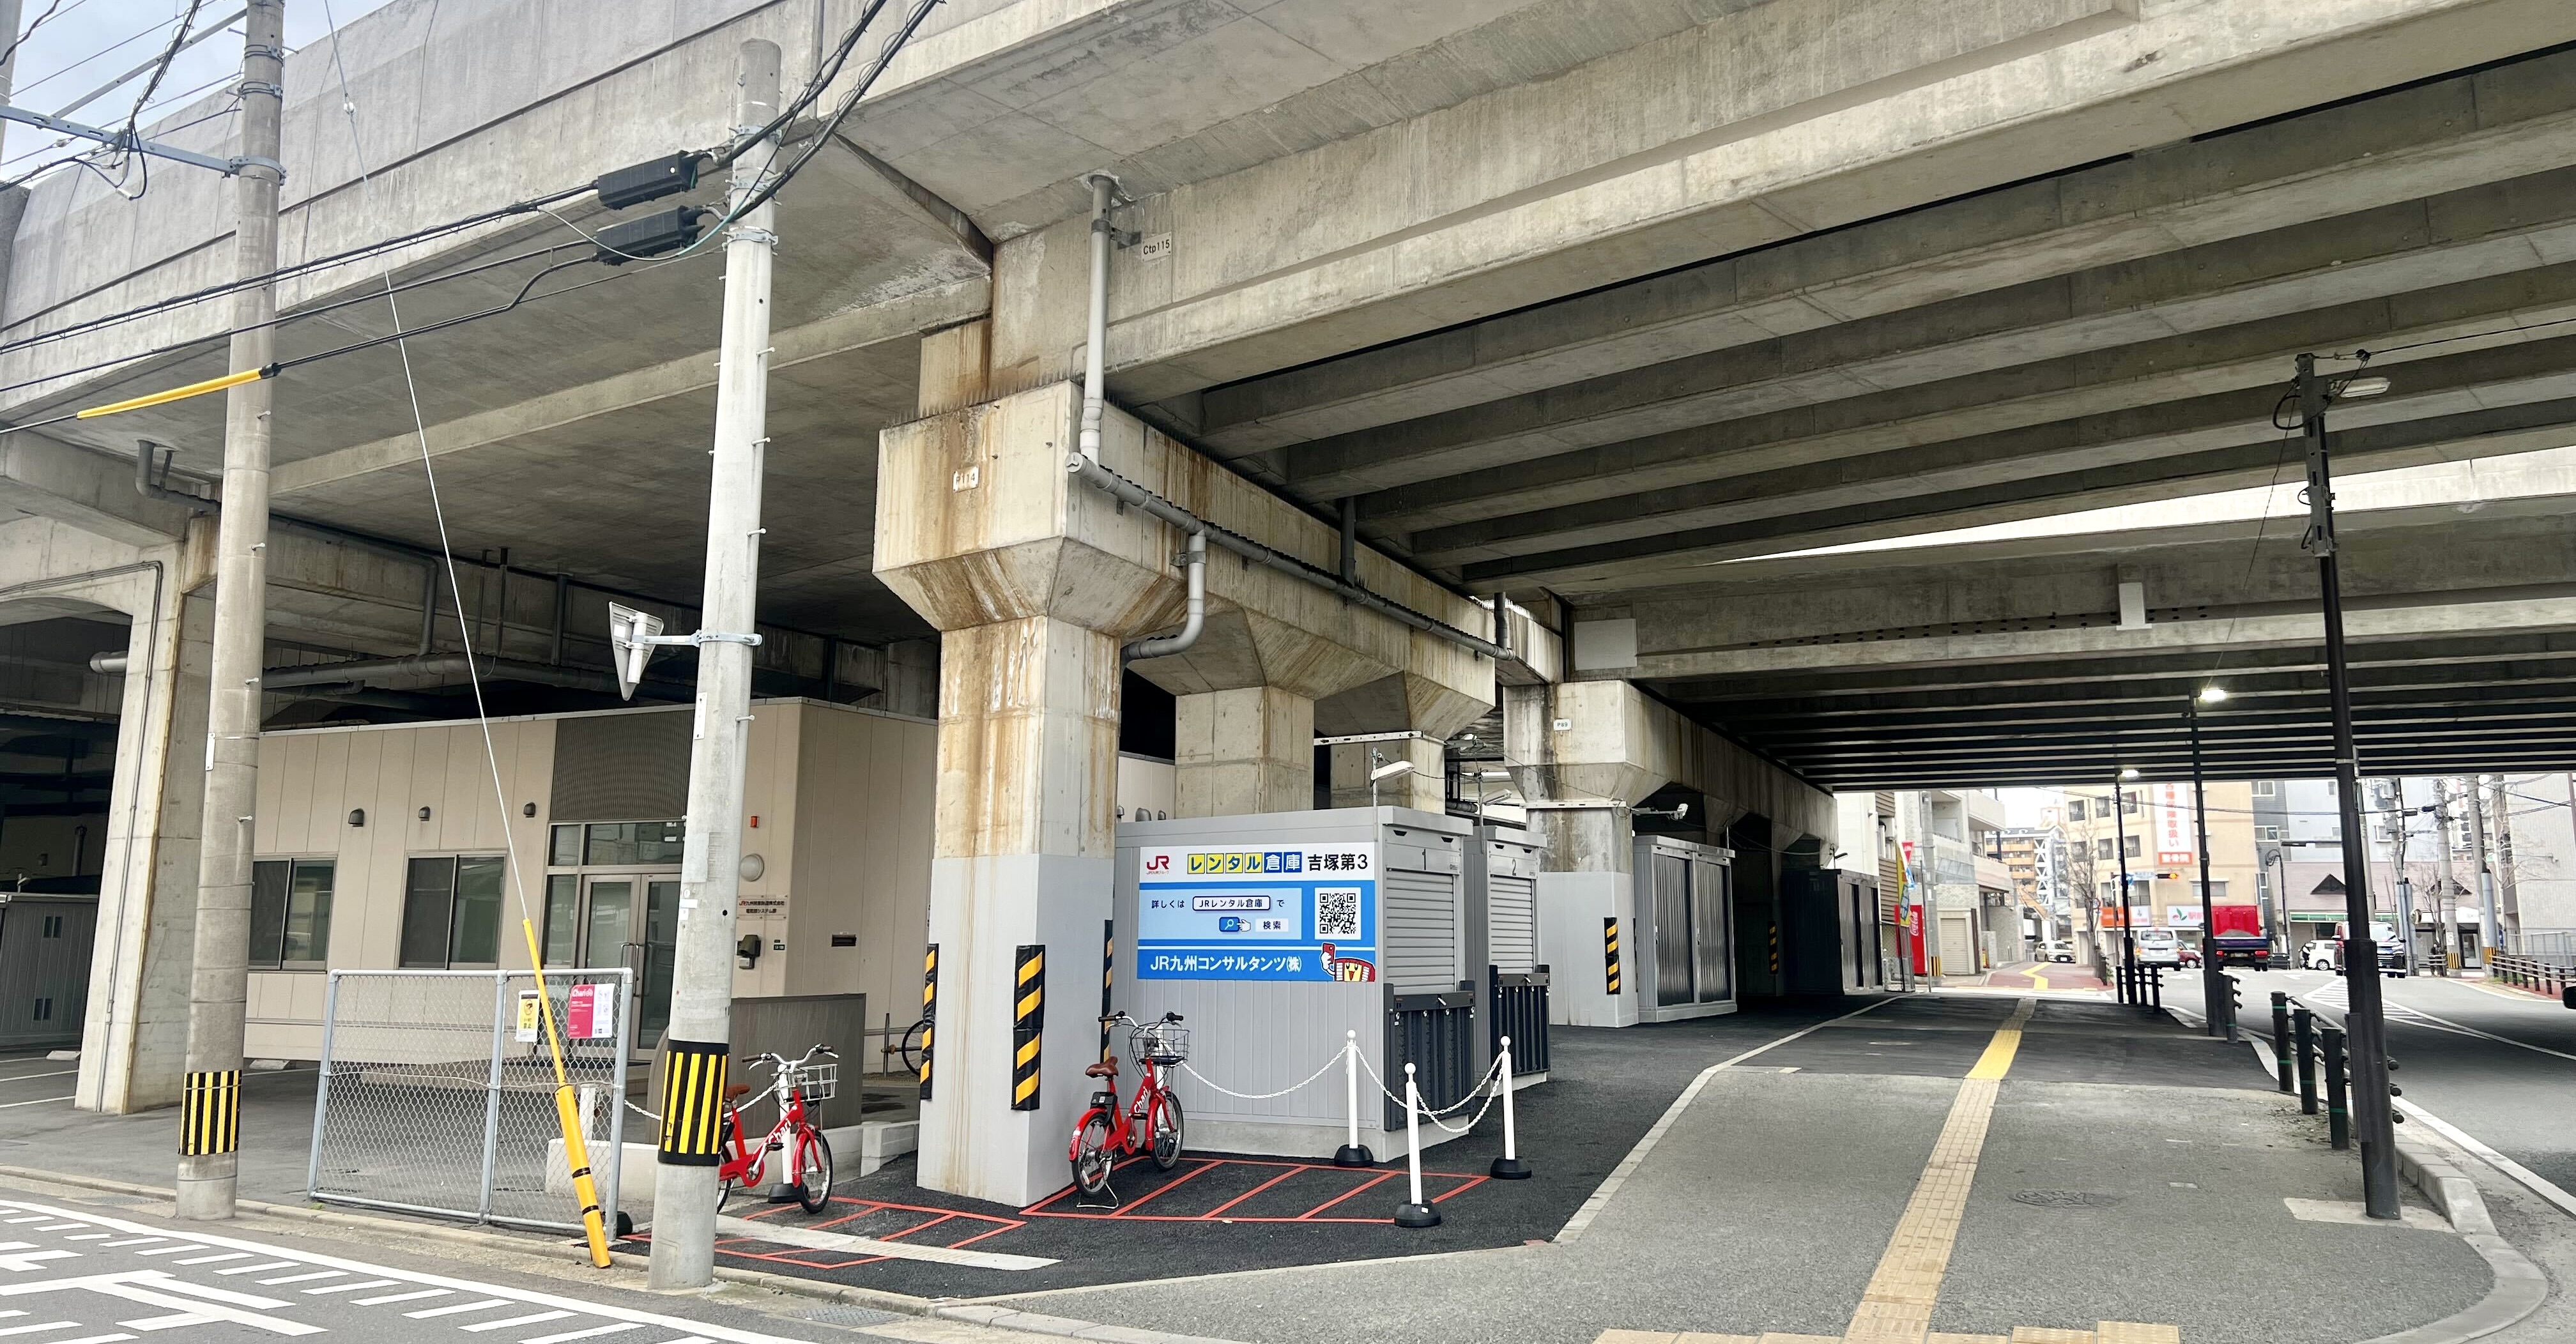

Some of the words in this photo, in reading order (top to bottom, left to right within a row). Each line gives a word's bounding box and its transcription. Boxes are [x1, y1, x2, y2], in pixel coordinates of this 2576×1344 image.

[1144, 239, 1170, 255] Ctp115
[1147, 856, 1169, 870] JR
[1190, 853, 1301, 873] レンタル倉庫
[1308, 853, 1368, 871] 吉塚第3
[1512, 858, 1517, 876] 2
[1151, 900, 1185, 908] 詳しくは
[1199, 899, 1263, 908] JRレンタル倉庫
[1263, 920, 1281, 929] 検索
[1134, 1086, 1148, 1113] Chari
